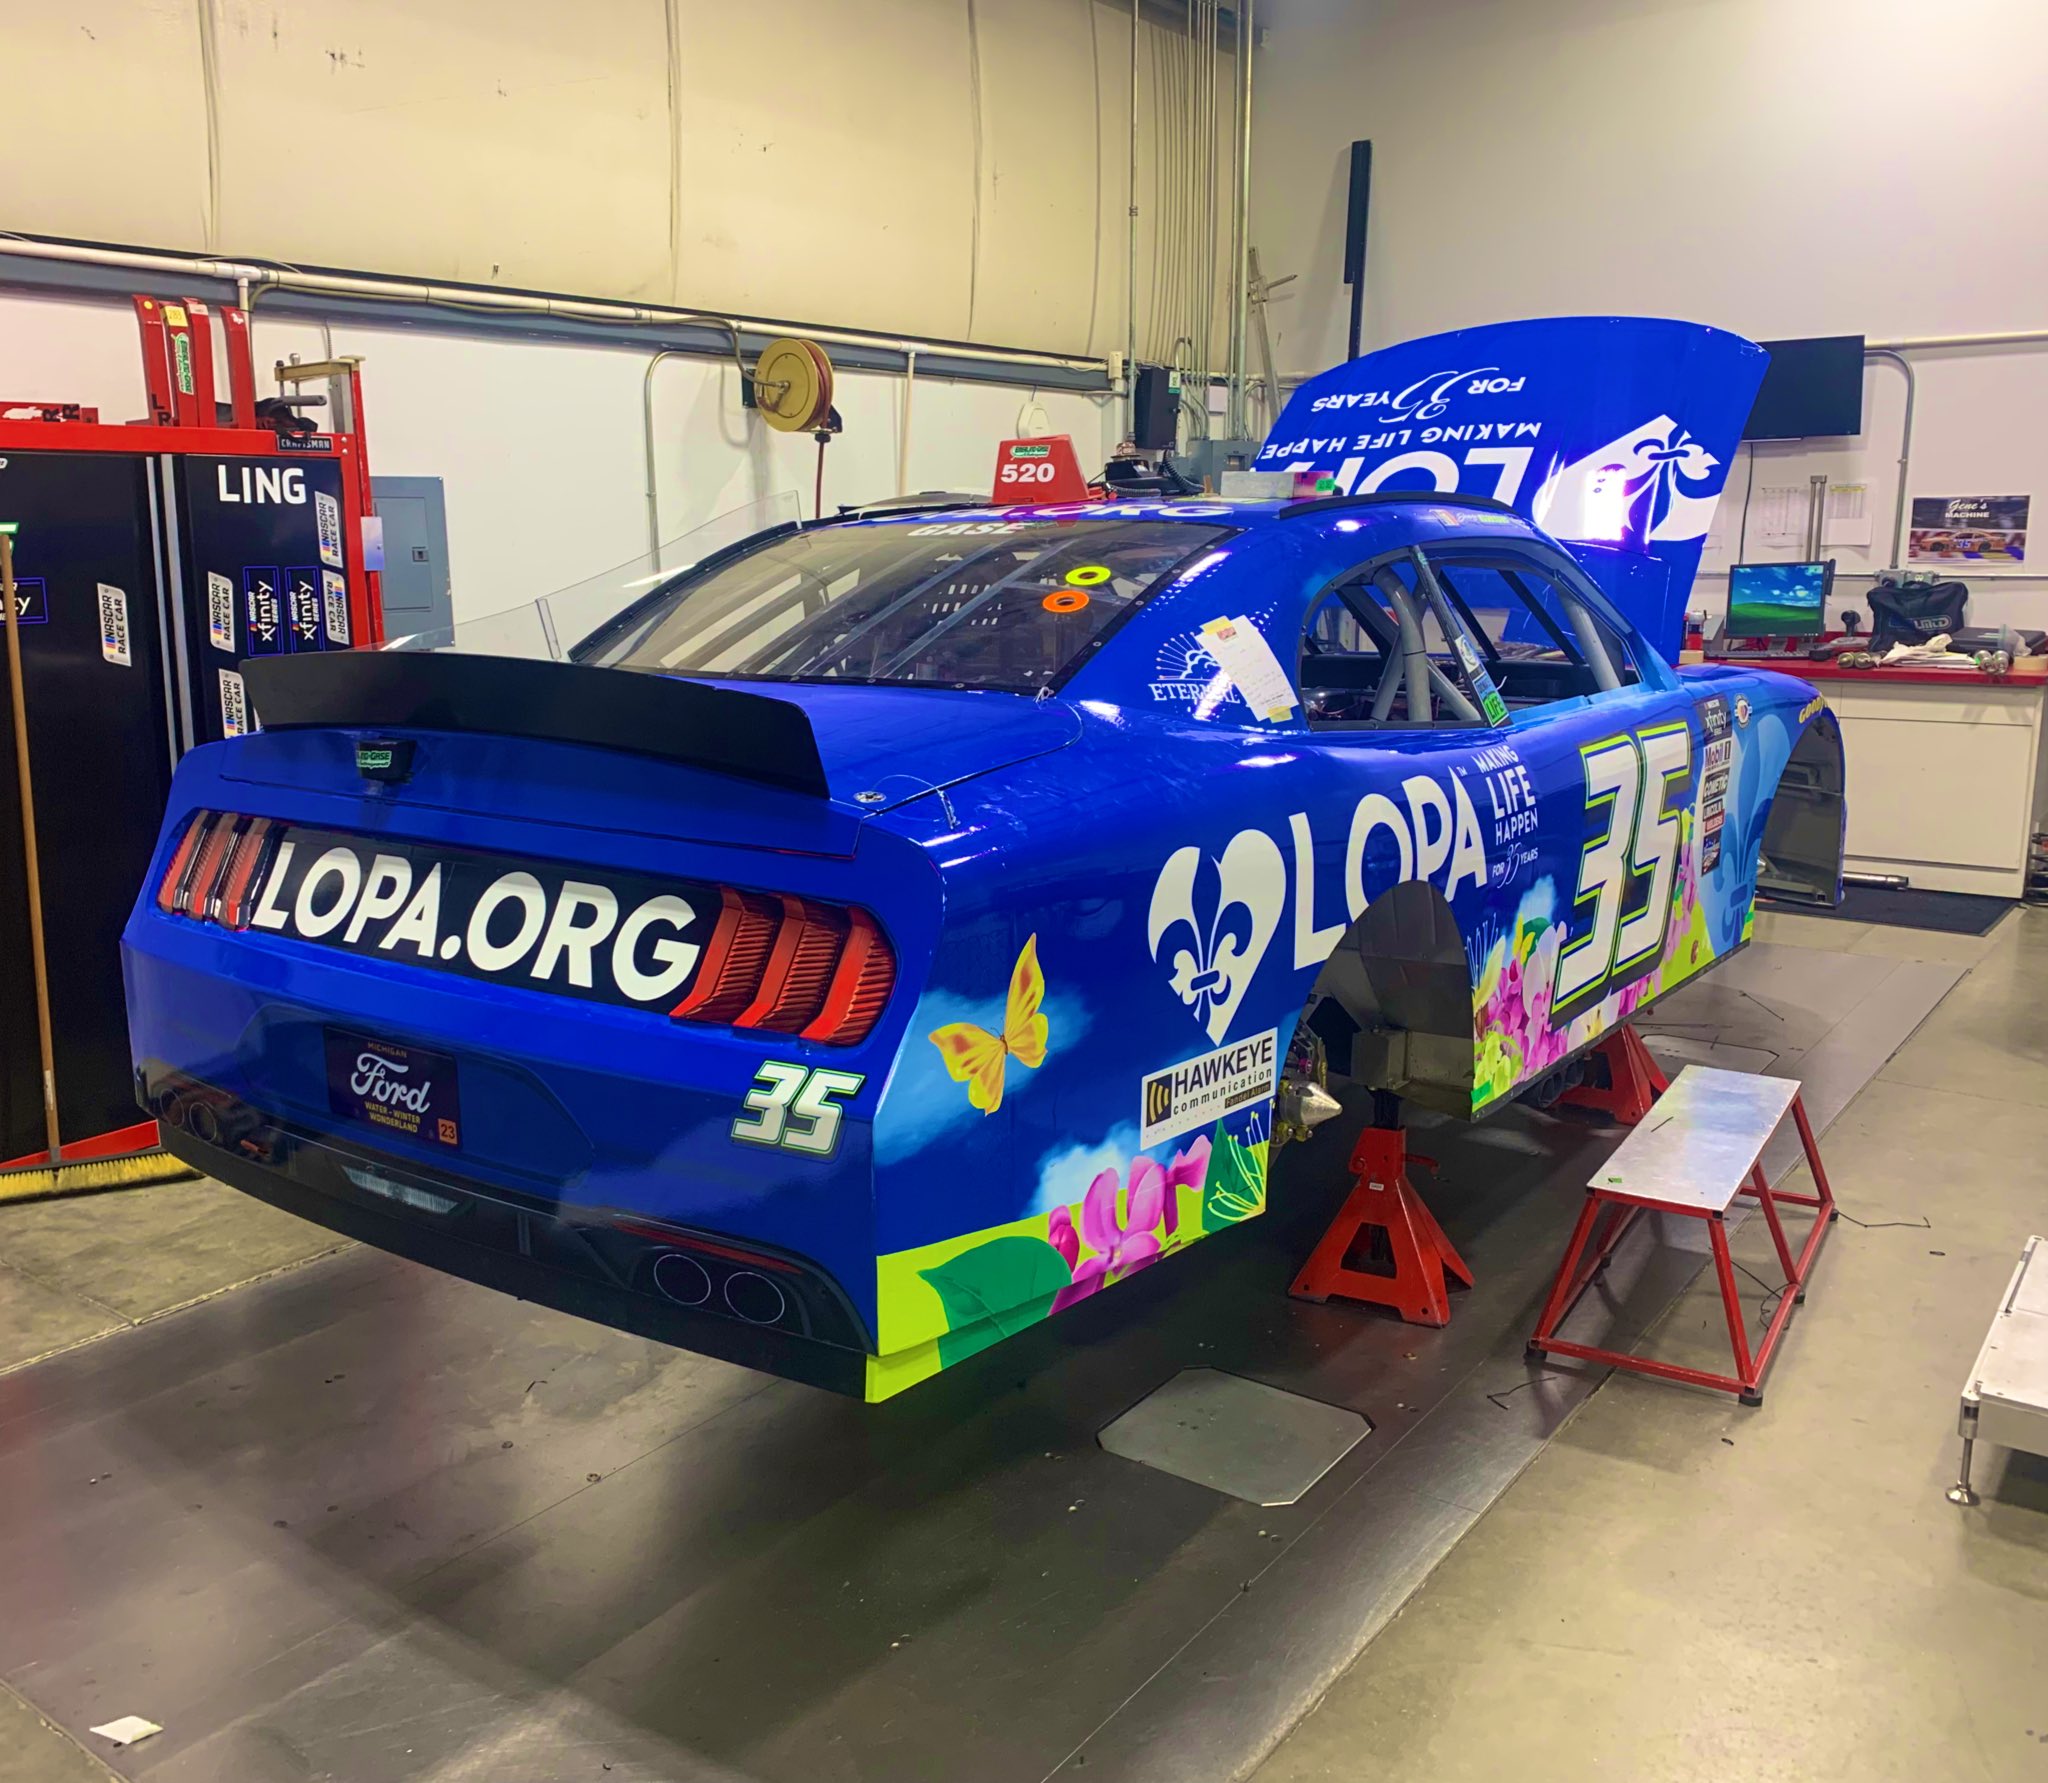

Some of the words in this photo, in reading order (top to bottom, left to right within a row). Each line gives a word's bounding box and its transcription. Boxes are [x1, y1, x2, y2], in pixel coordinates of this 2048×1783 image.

[1378, 367, 1500, 424] 35
[1468, 376, 1526, 395] FOR
[1311, 390, 1391, 413] YEARS
[1353, 429, 1413, 450] LIFE
[1420, 422, 1542, 443] MAKING
[1256, 436, 1347, 460] HAPPE
[217, 464, 307, 505] LING
[1001, 462, 1055, 483] 520
[328, 505, 336, 527] CAR
[1949, 498, 1988, 512] Gene's
[319, 502, 330, 546] NASCAR
[907, 522, 1026, 536] GASE
[330, 531, 339, 557] RACE
[212, 583, 222, 629] NASCAR
[222, 587, 230, 610] CAR
[326, 581, 334, 606] RACE
[102, 595, 116, 643] NASCAR
[115, 598, 123, 623] CAR
[257, 580, 276, 641] xfinity
[298, 580, 318, 641] xfinity
[328, 609, 337, 632] CAR
[335, 590, 346, 635] NASCAR
[116, 624, 127, 654] RACE
[224, 612, 232, 641] RACE
[223, 680, 235, 725] NASCAR
[233, 682, 242, 704] CAR
[236, 708, 244, 734] RACE
[1471, 744, 1519, 774] MAKING
[1485, 765, 1536, 820] LIFE
[1495, 808, 1539, 846] HAPPEN
[1289, 765, 1487, 971] LOPA
[1497, 842, 1522, 889] 35
[1520, 847, 1539, 865] YEARS
[1551, 721, 1691, 1015] 35
[1492, 862, 1505, 878] FOR
[251, 841, 701, 1002] LOPA.ORG
[367, 1042, 407, 1058] MICHIGAN
[1174, 1036, 1273, 1098] HAWKEYE
[351, 1053, 431, 1113] Ford
[1173, 1068, 1272, 1115] communication
[364, 1101, 388, 1114] WATER
[393, 1109, 421, 1124] WINTER
[730, 1060, 866, 1155] 35
[369, 1112, 418, 1133] WONDERLAND
[440, 1123, 455, 1139] 23
